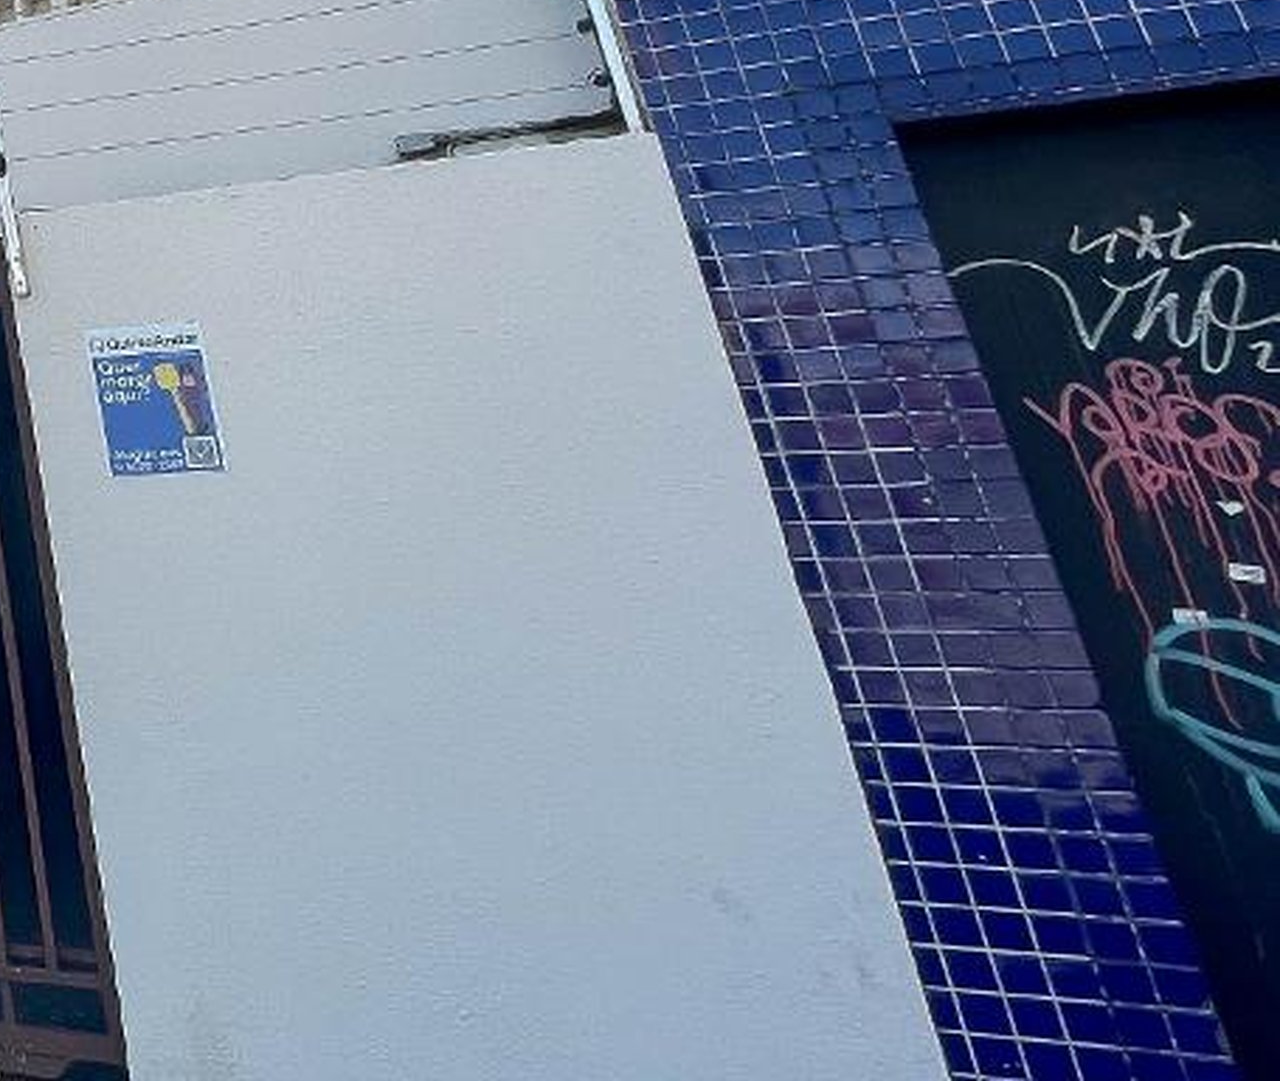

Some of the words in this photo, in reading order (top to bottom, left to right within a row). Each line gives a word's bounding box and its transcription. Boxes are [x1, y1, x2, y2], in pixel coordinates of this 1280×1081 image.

[98, 360, 140, 376] Quer
[100, 373, 152, 390] morar
[103, 388, 151, 405] aqui?
